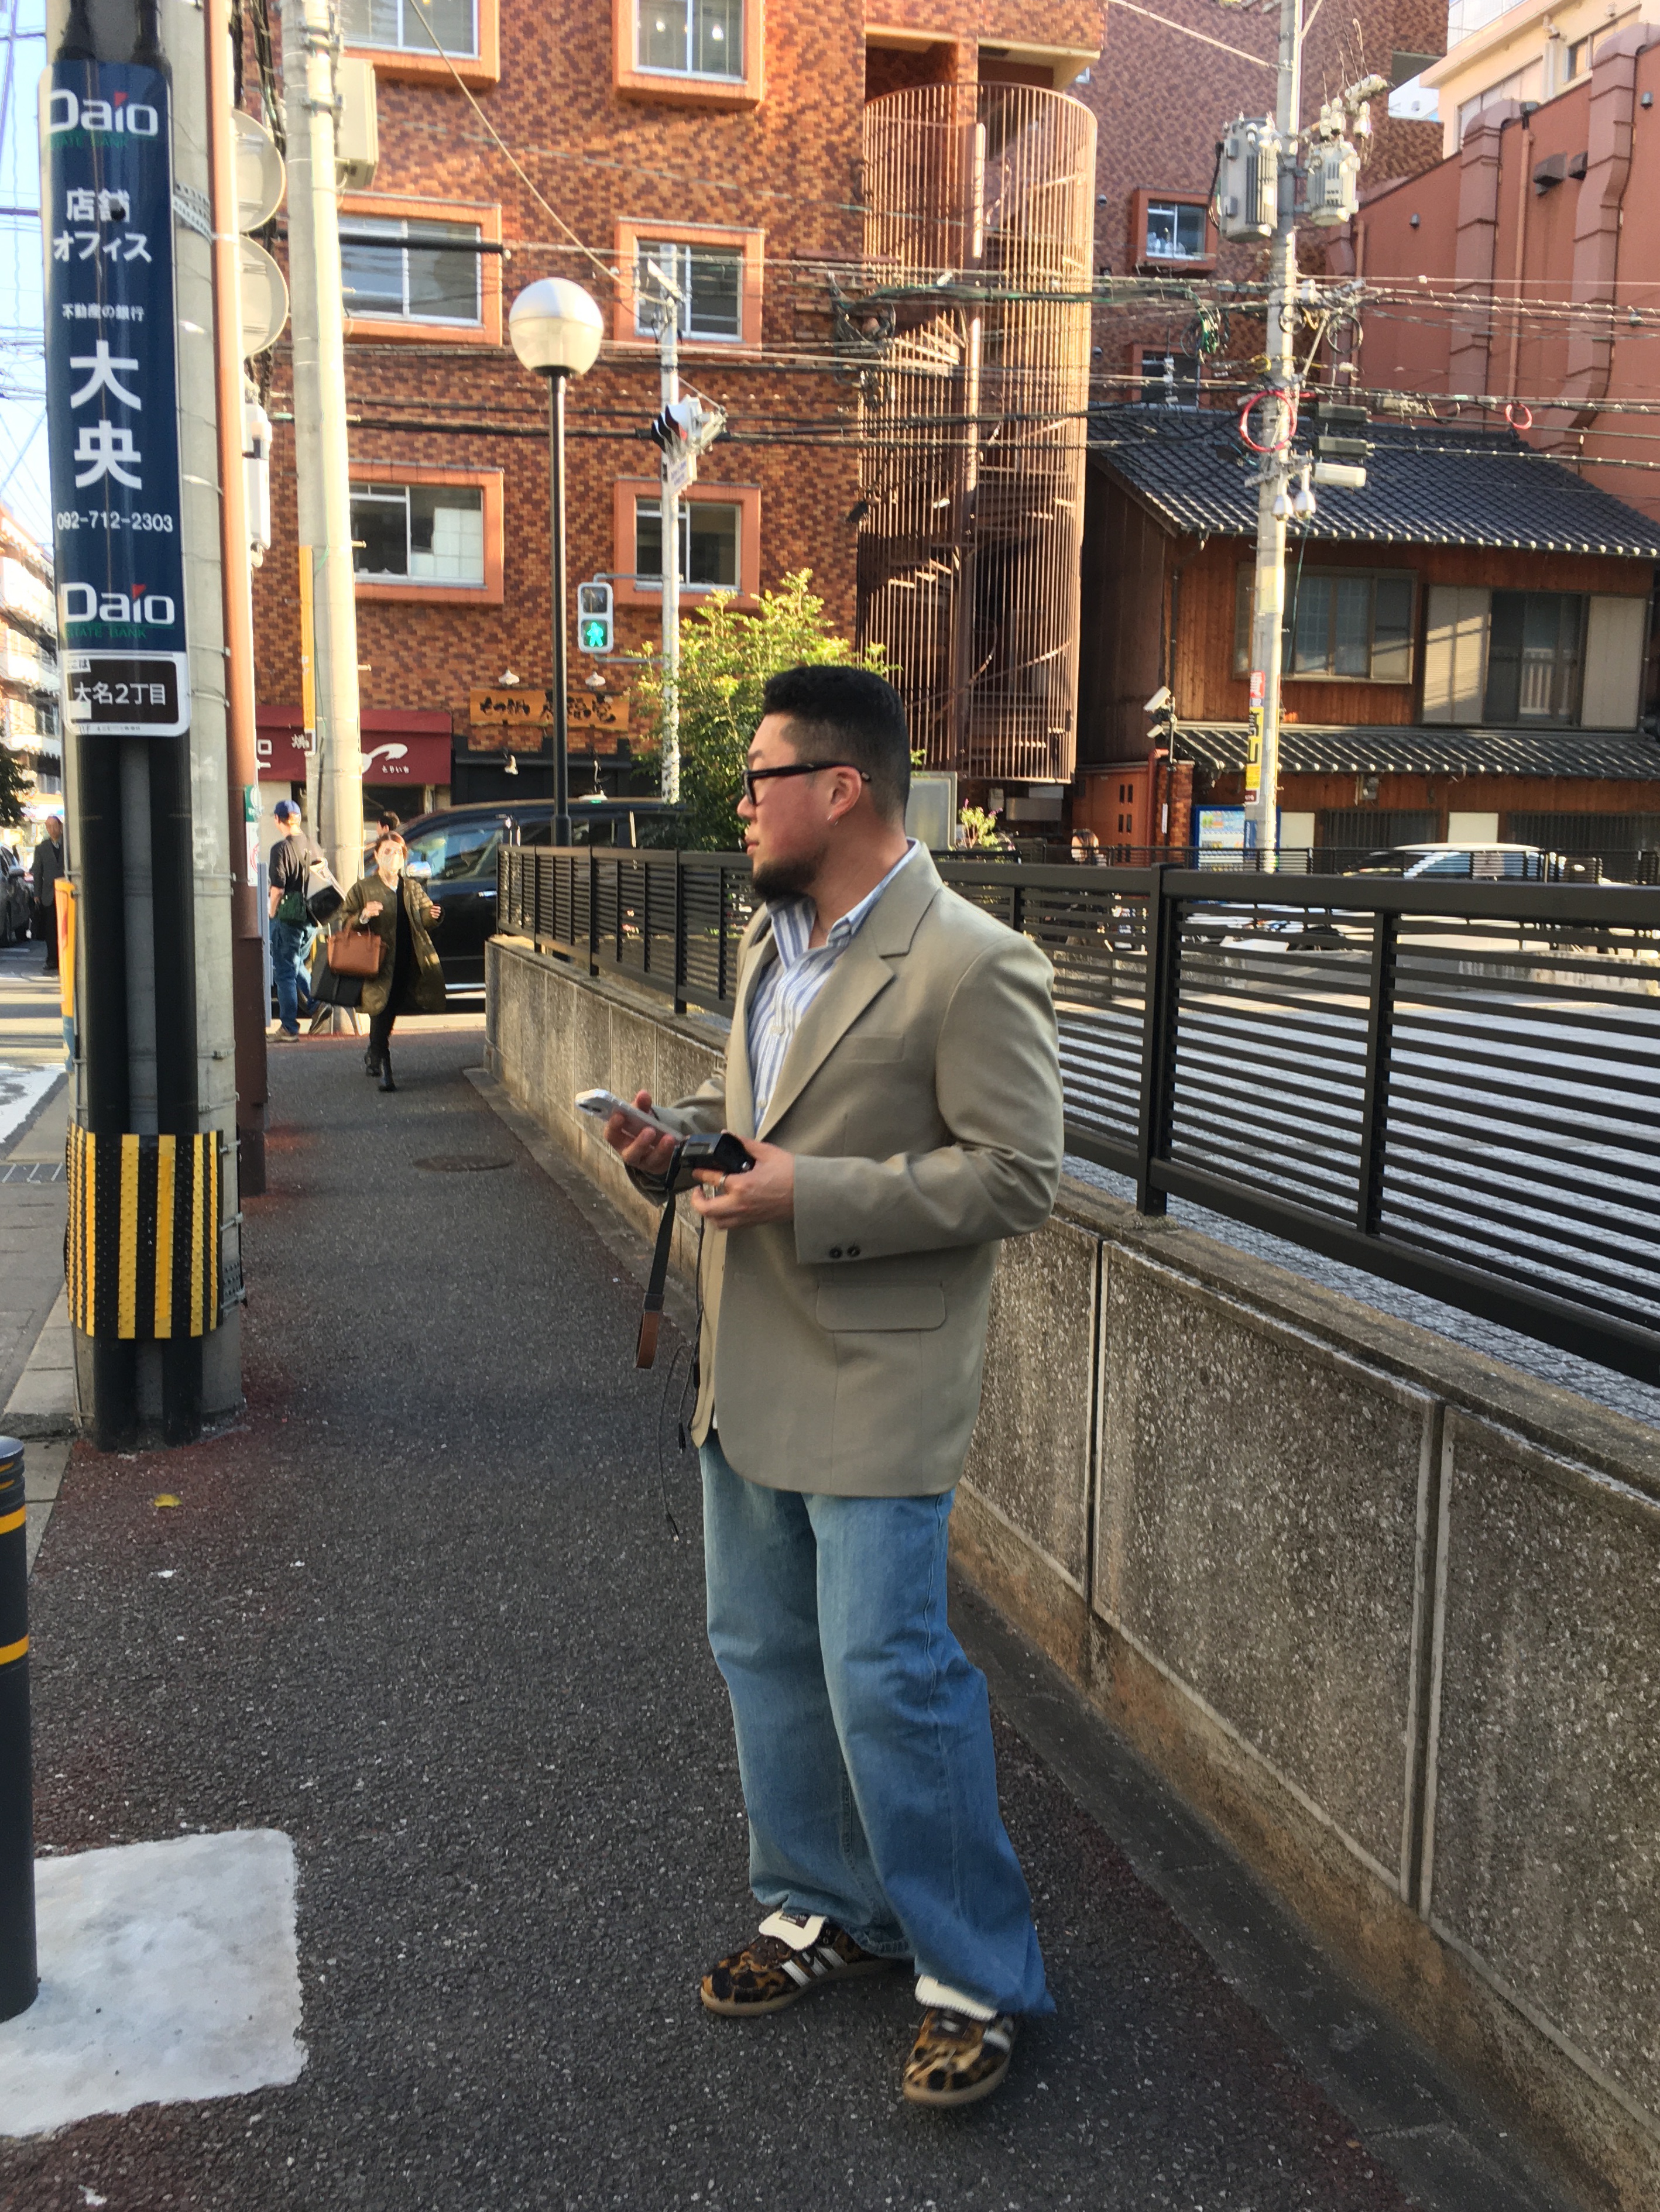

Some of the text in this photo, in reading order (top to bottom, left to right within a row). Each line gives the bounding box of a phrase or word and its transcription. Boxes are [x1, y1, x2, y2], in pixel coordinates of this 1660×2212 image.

[49, 88, 159, 136] Daio
[66, 187, 130, 223] 店舗
[53, 230, 152, 263] オフィス
[62, 303, 145, 322] 不動産の銀行
[57, 510, 173, 533] 092-712-2303
[61, 582, 175, 625] Daio
[74, 681, 166, 706] 大名2丁目
